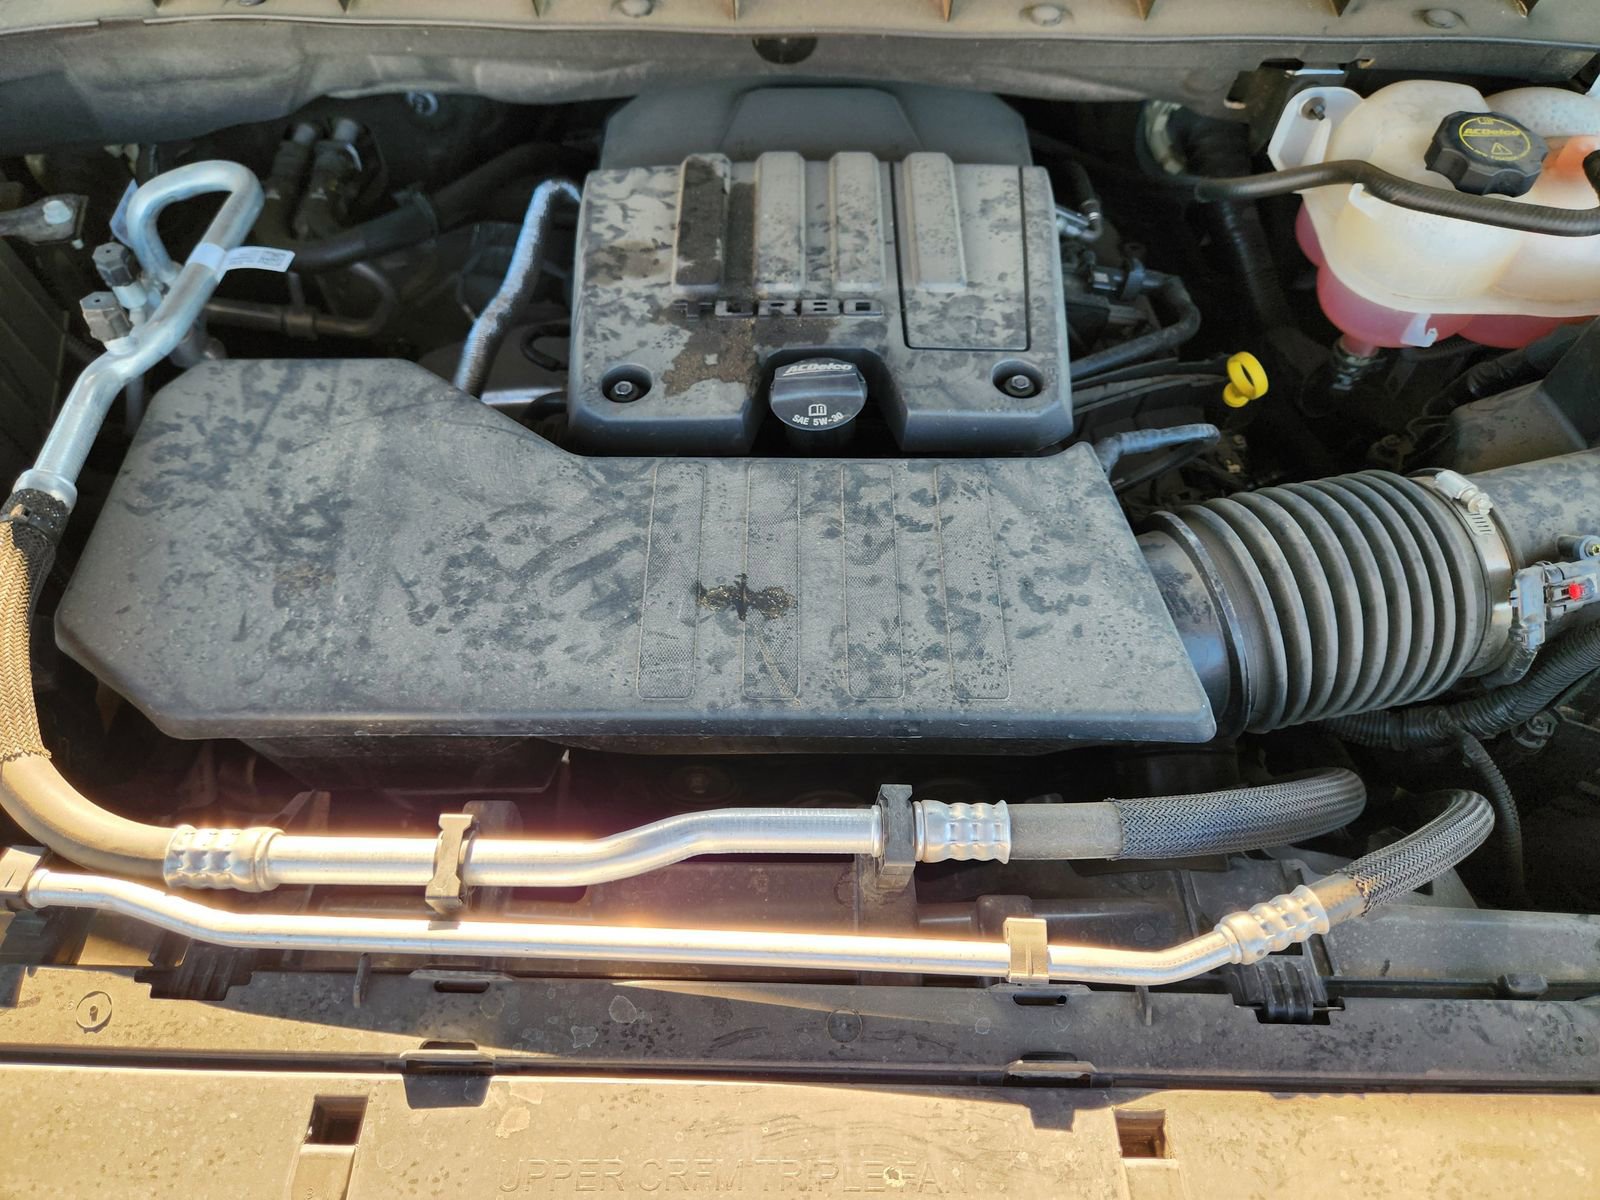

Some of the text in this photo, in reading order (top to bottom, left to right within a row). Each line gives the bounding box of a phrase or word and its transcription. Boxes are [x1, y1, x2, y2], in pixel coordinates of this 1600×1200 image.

[1462, 128, 1521, 137] ACDelco
[673, 299, 884, 319] TURBO
[782, 362, 853, 376] ACDelco
[792, 412, 844, 426] SAE 5W-30
[498, 1158, 626, 1193] UPPER
[754, 1159, 886, 1193] TRIPLE
